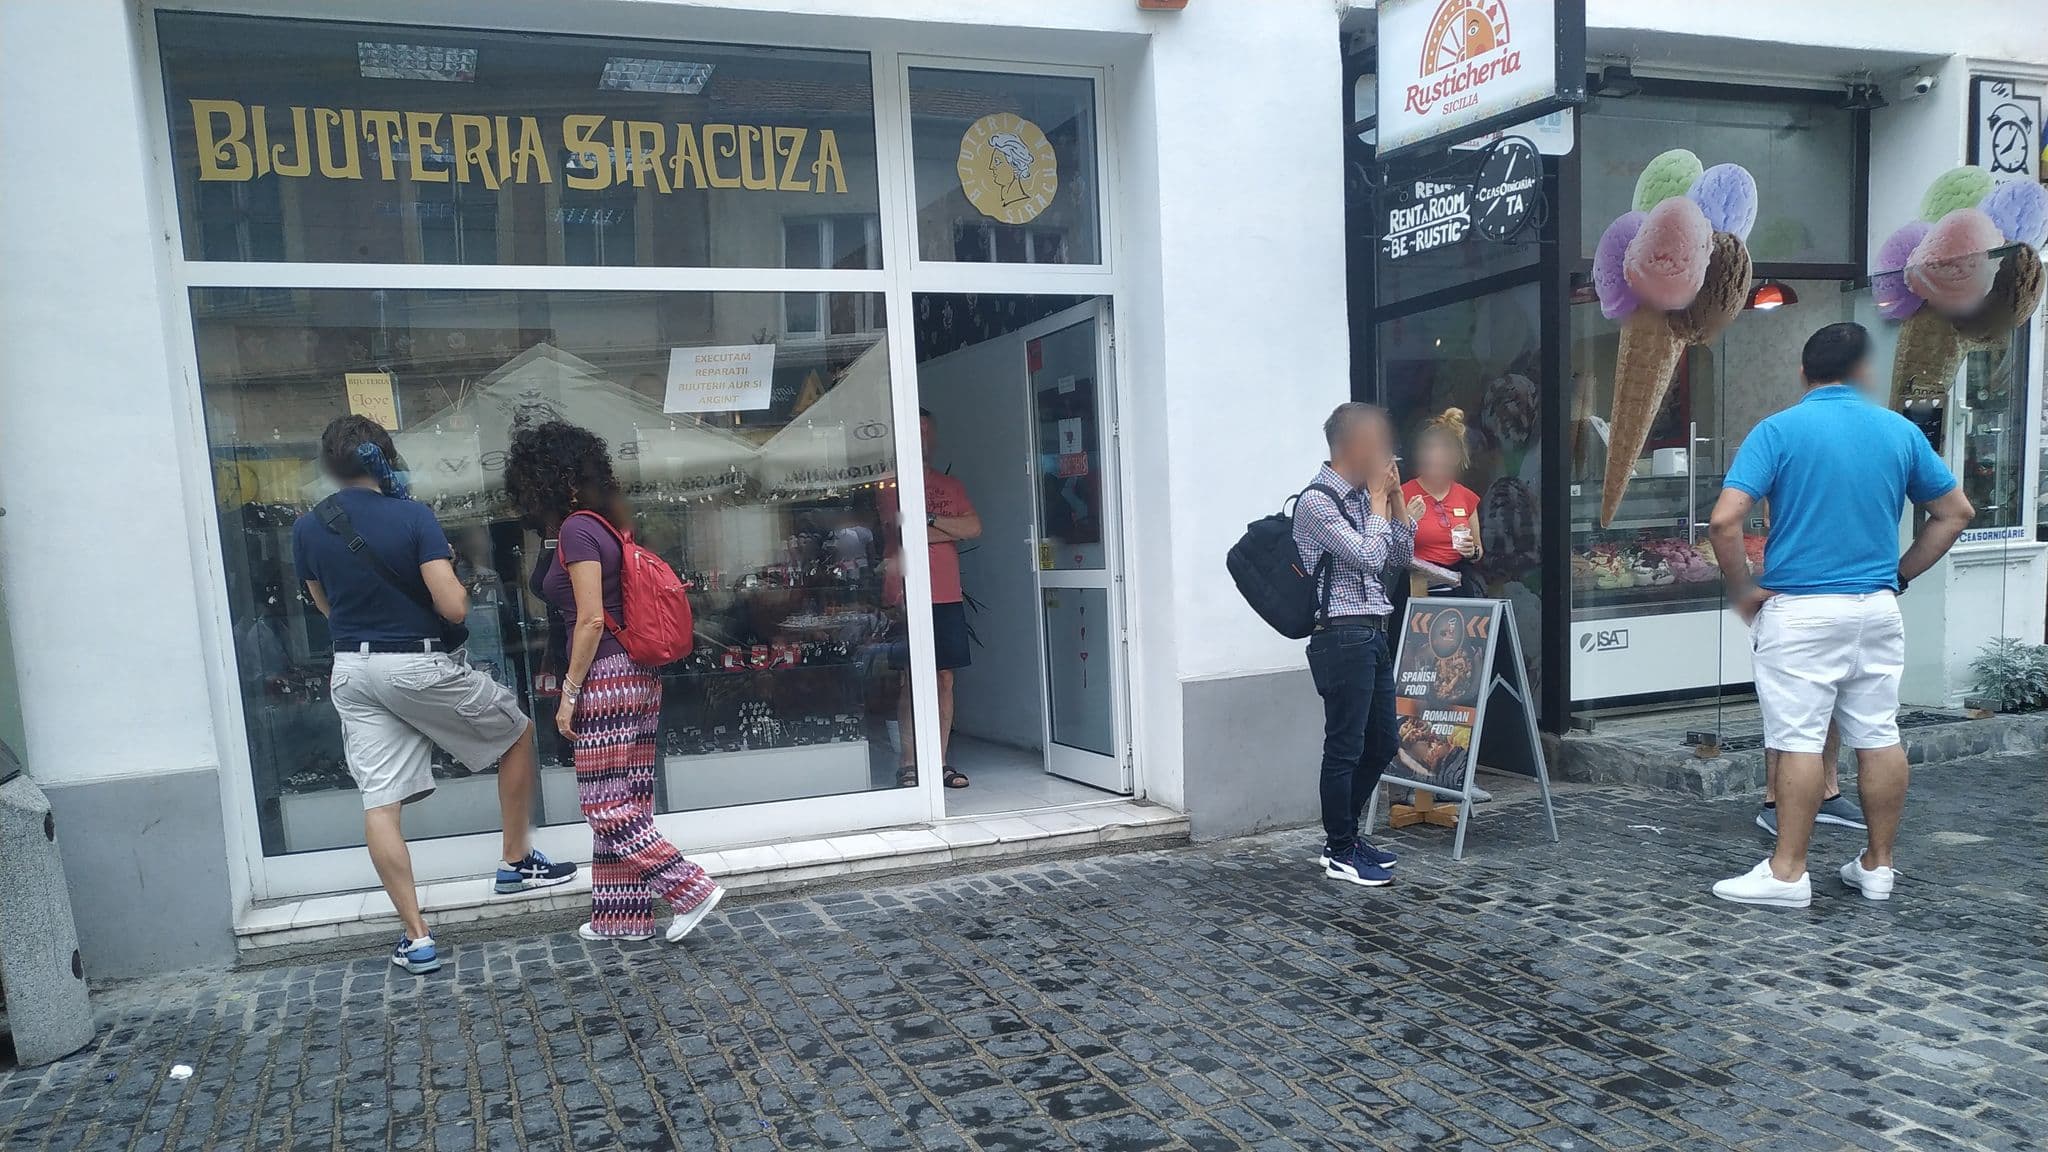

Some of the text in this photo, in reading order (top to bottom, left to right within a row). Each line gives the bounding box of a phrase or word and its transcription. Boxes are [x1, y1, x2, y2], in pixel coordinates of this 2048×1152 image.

[1404, 48, 1521, 115] Rusticheria
[1442, 93, 1478, 115] SICILIA
[188, 99, 848, 193] BIJUTERIA SIRACUZA
[1505, 193, 1524, 216] TA
[1390, 192, 1465, 234] RENT A ROOM
[695, 352, 752, 363] EXECUTAM
[695, 367, 748, 377] REPARATII
[727, 380, 750, 390] AUR
[699, 395, 739, 405] ARGINT
[1597, 631, 1620, 647] ISA
[1401, 671, 1437, 683] SPANISH
[1404, 684, 1427, 695] FOOD
[1422, 710, 1470, 723] ROMANIAN
[1430, 724, 1454, 736] FOOD
